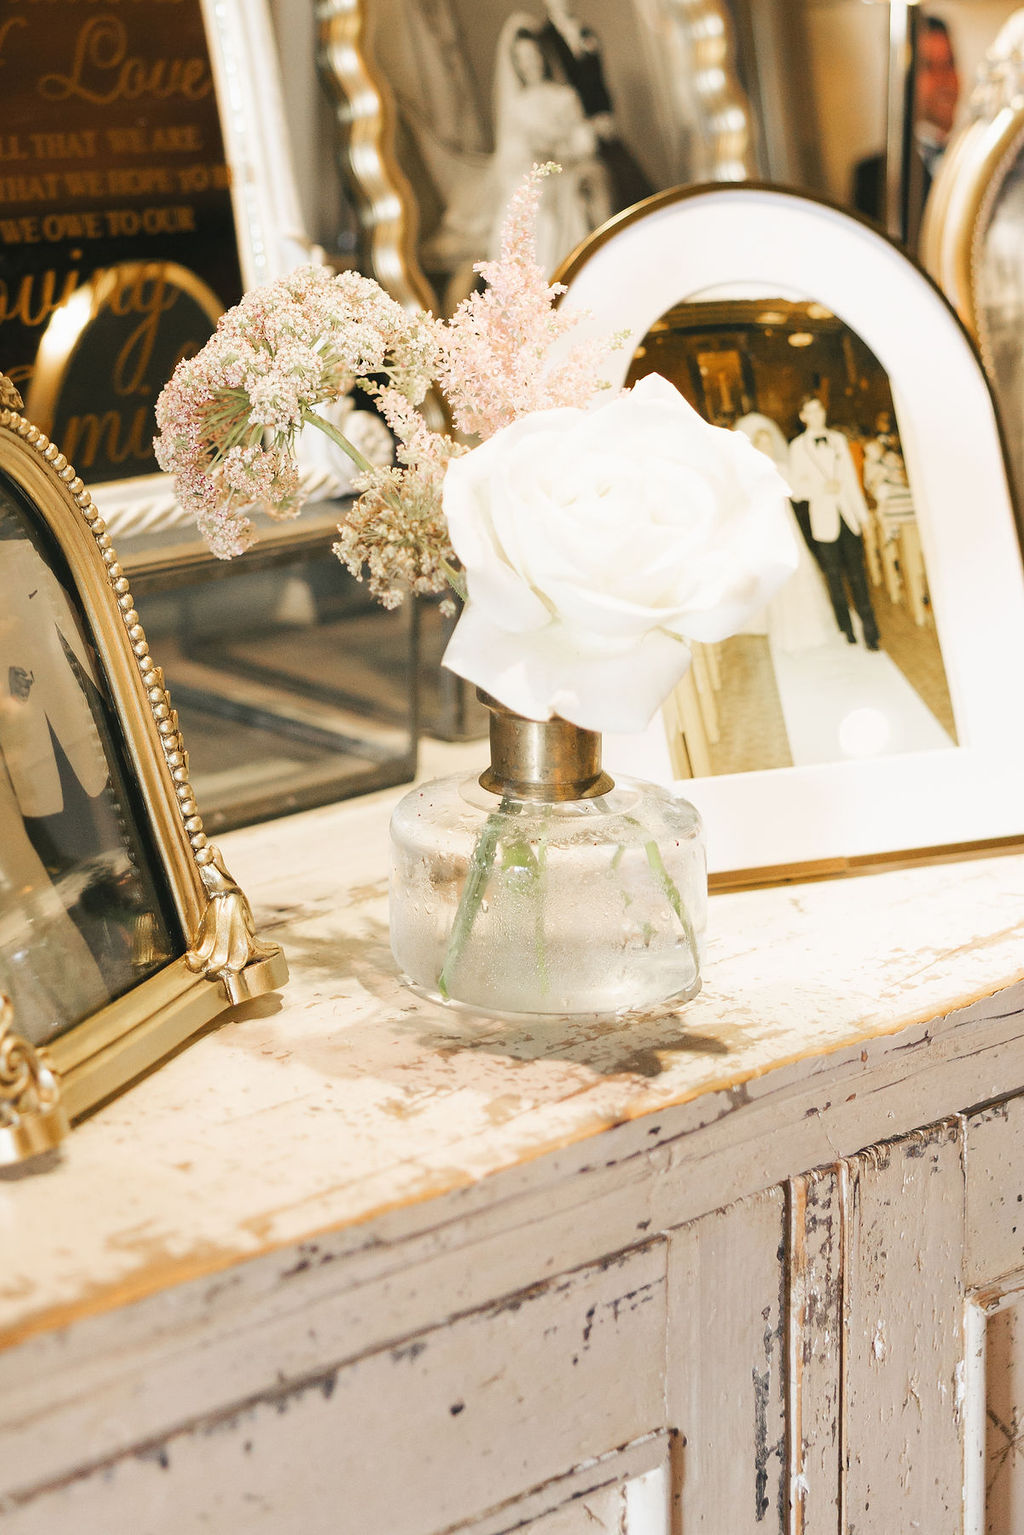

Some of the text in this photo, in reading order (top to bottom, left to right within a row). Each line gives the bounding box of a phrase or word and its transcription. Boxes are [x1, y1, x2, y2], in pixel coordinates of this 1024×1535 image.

[37, 14, 213, 105] Love
[29, 129, 97, 159] THAT
[64, 170, 105, 198] WE
[178, 165, 209, 194] TO
[104, 209, 140, 237] TO
[142, 206, 196, 235] OUR
